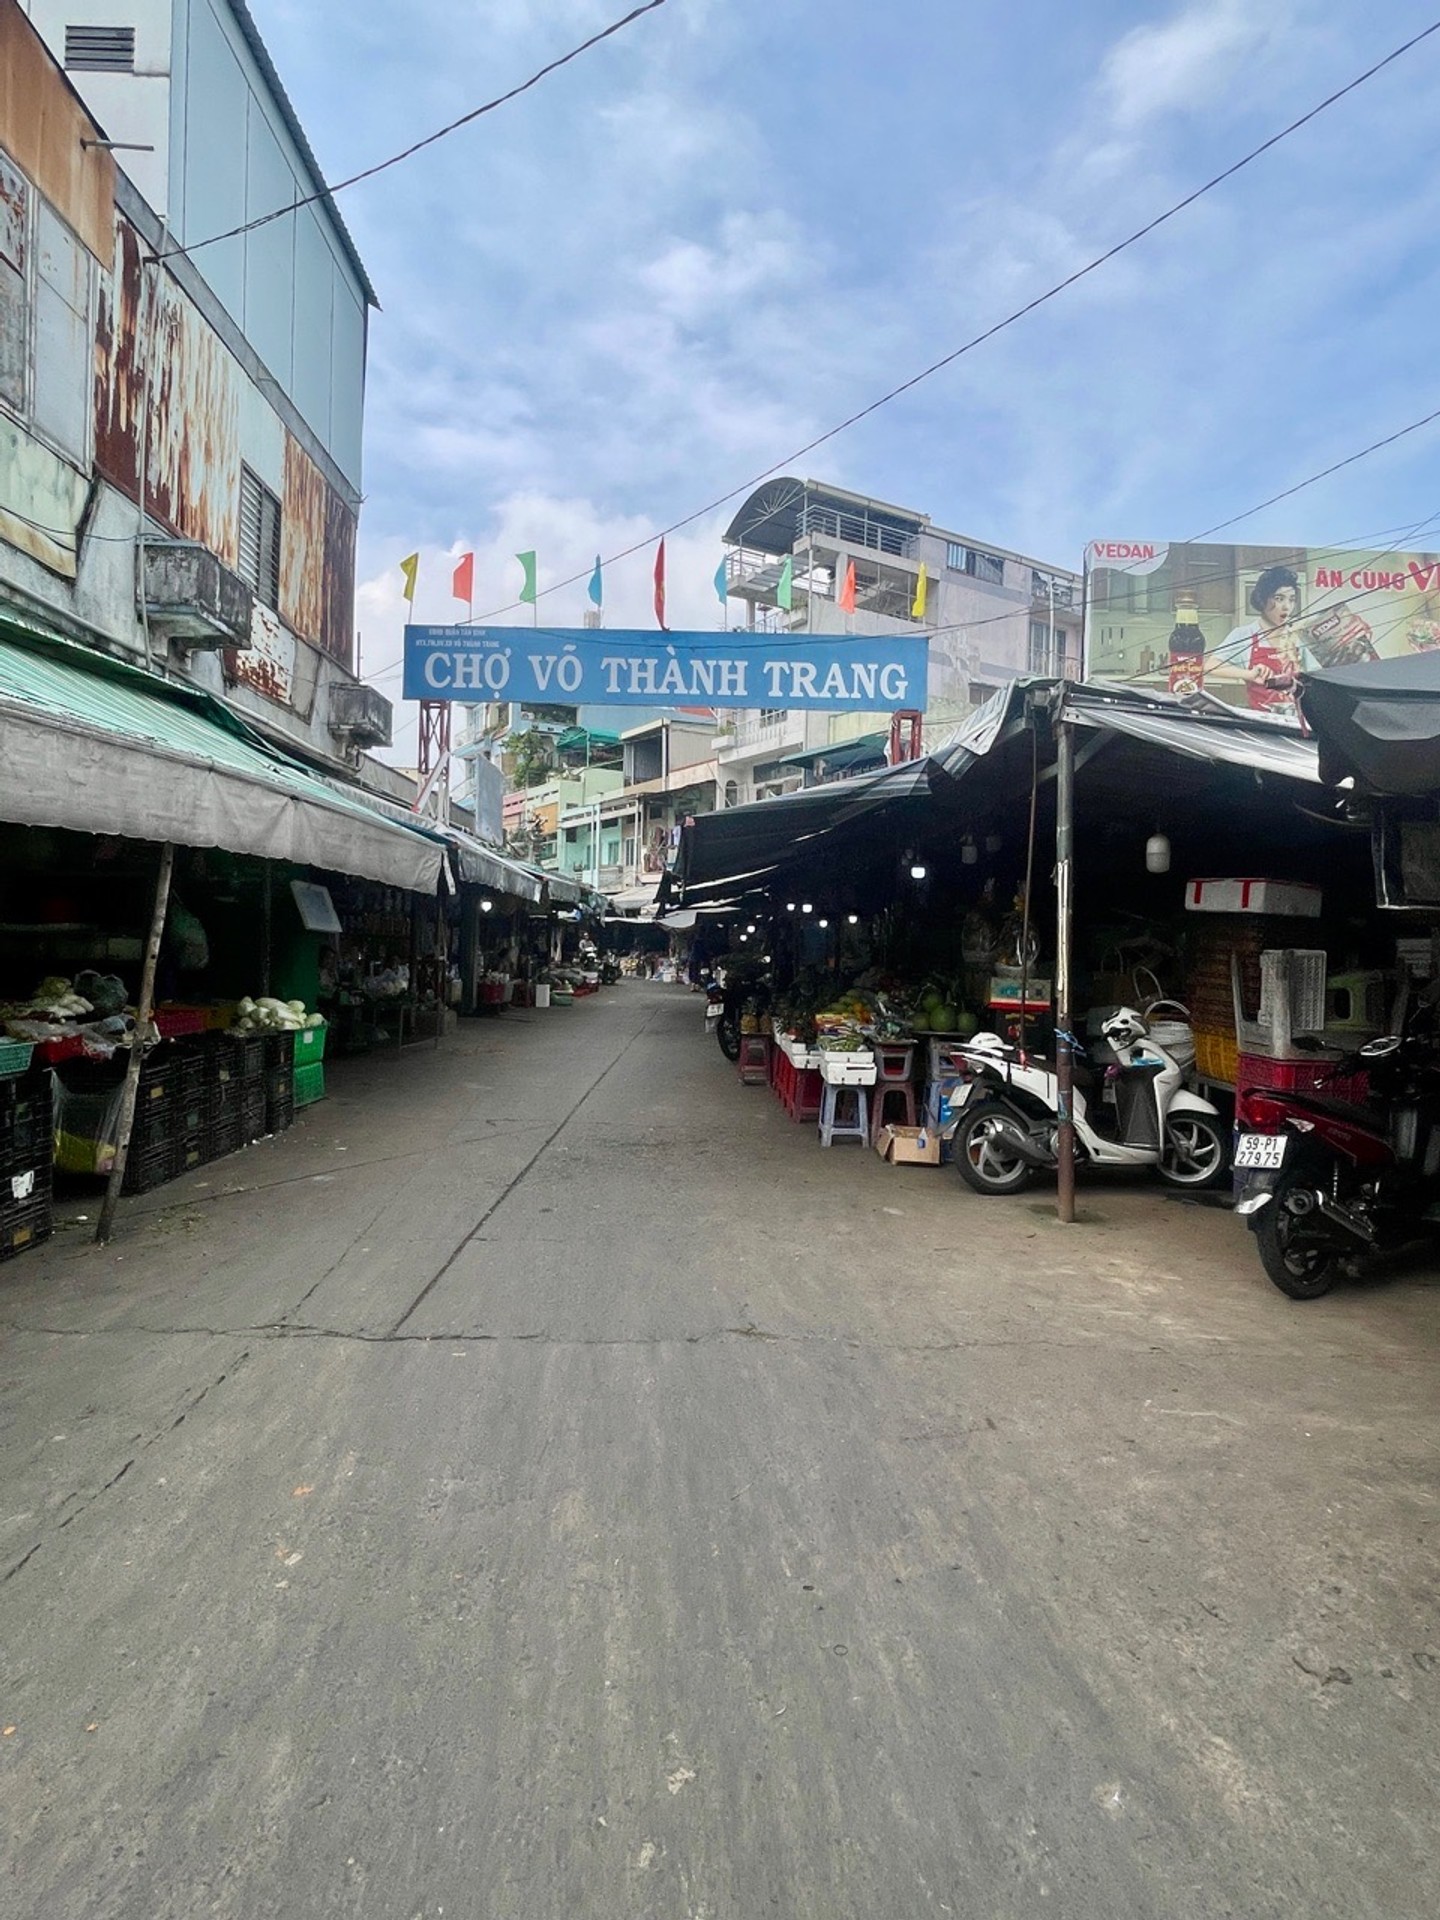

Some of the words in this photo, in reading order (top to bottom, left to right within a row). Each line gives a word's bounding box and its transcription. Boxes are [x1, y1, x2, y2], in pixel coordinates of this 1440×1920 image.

[1094, 543, 1154, 559] VEDAN
[1315, 566, 1342, 588] ĂN
[1349, 568, 1406, 591] CÙNG
[1408, 561, 1440, 592] V
[424, 647, 511, 699] CHỢ
[528, 643, 584, 692] VÕ
[600, 644, 749, 696] THÀNH
[762, 660, 909, 701] TRANG
[1245, 1136, 1278, 1151] 59-P1
